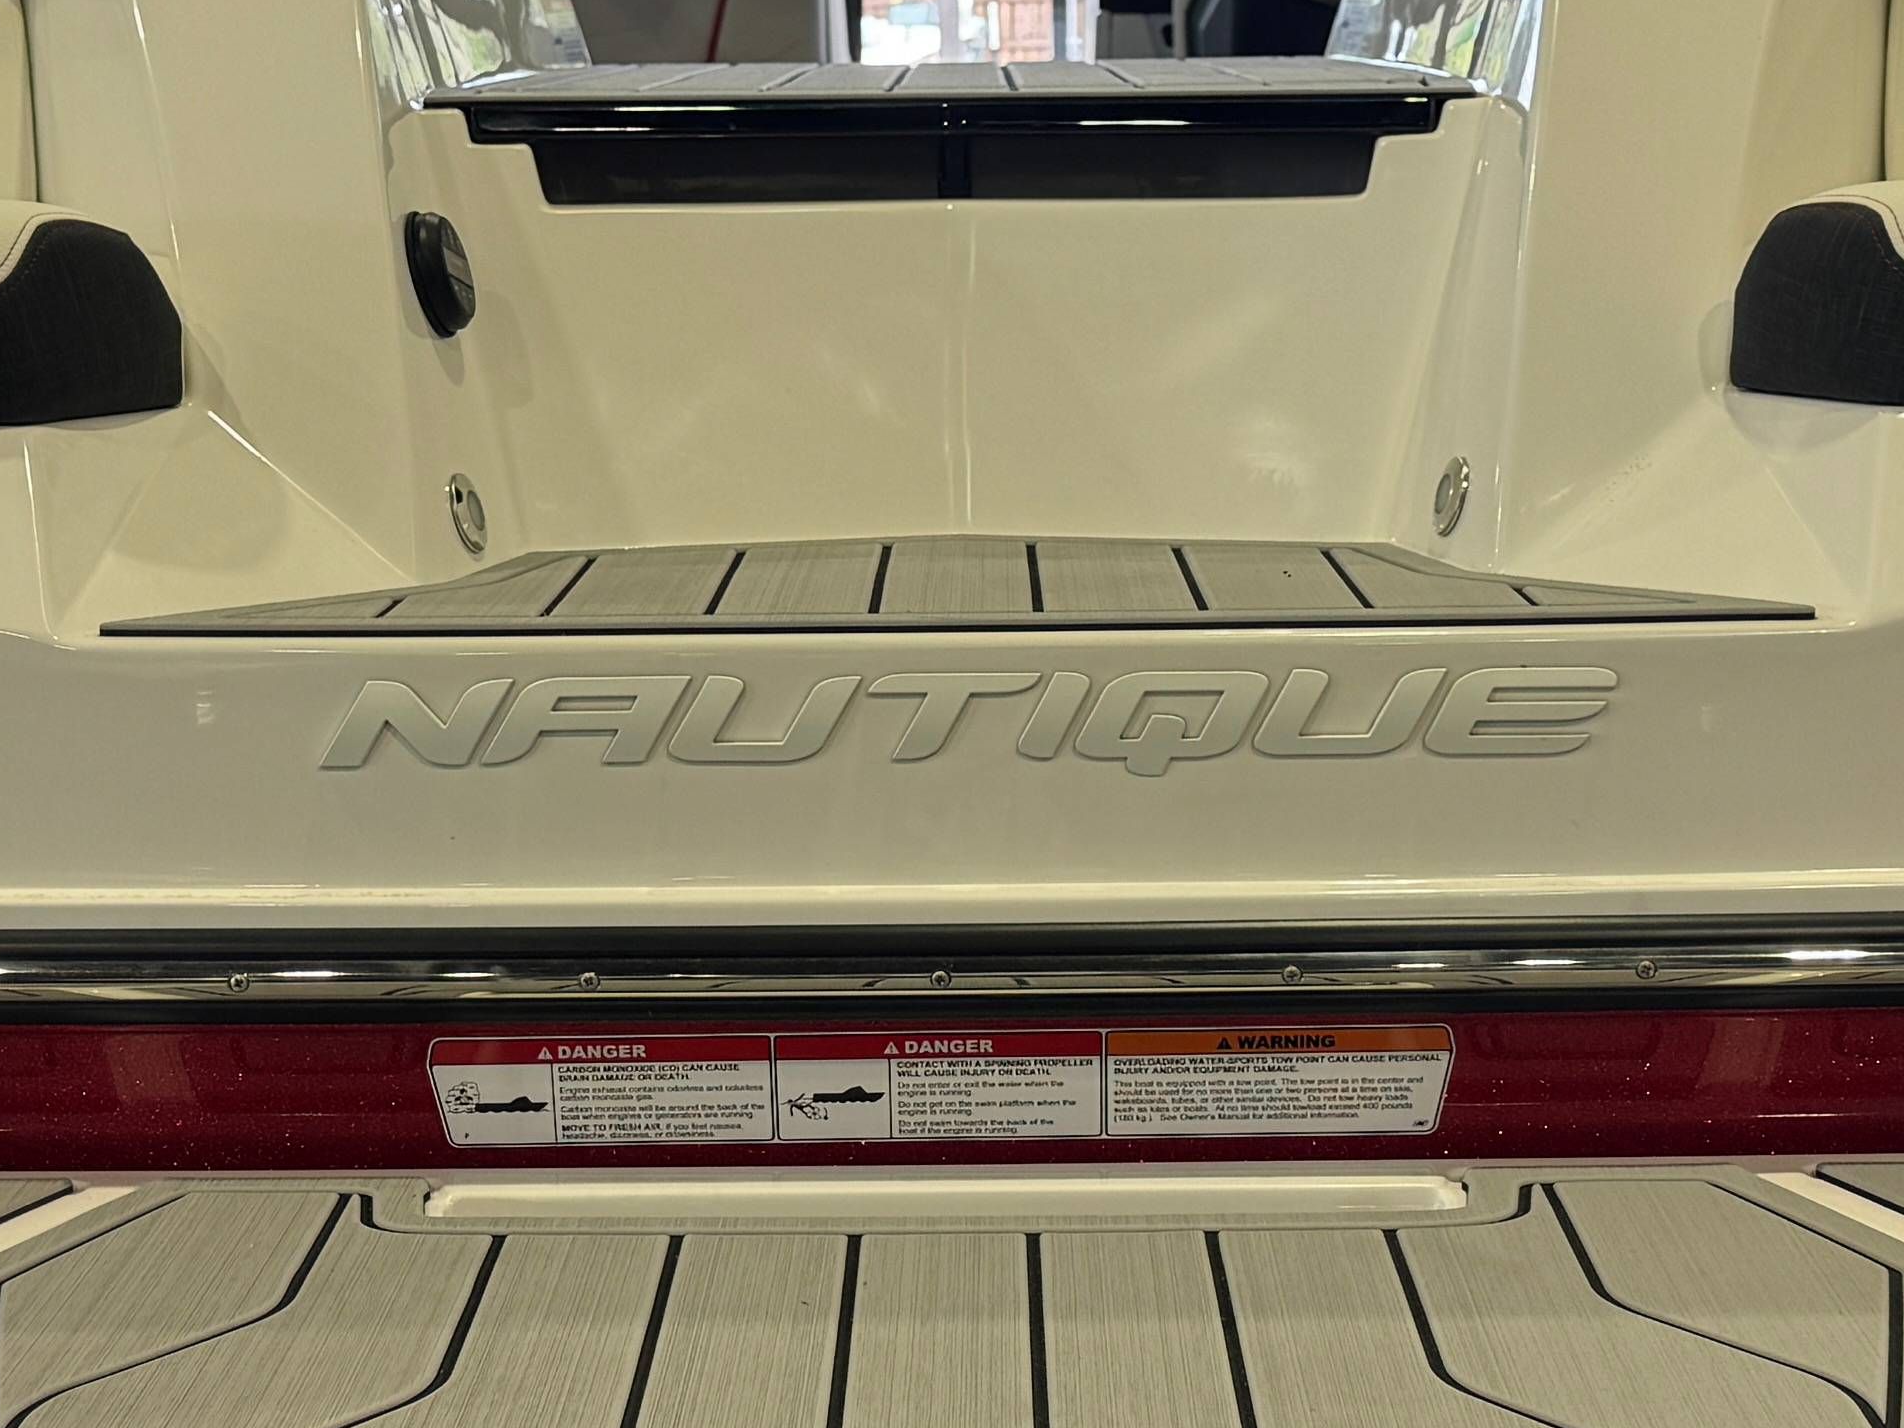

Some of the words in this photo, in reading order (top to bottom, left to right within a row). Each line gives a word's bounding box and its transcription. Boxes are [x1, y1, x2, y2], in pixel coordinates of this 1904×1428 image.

[319, 666, 1621, 776] NAUTIQUE
[904, 1039, 993, 1054] DANGER
[1237, 1034, 1336, 1049] WARNING
[557, 1044, 646, 1059] DANGER
